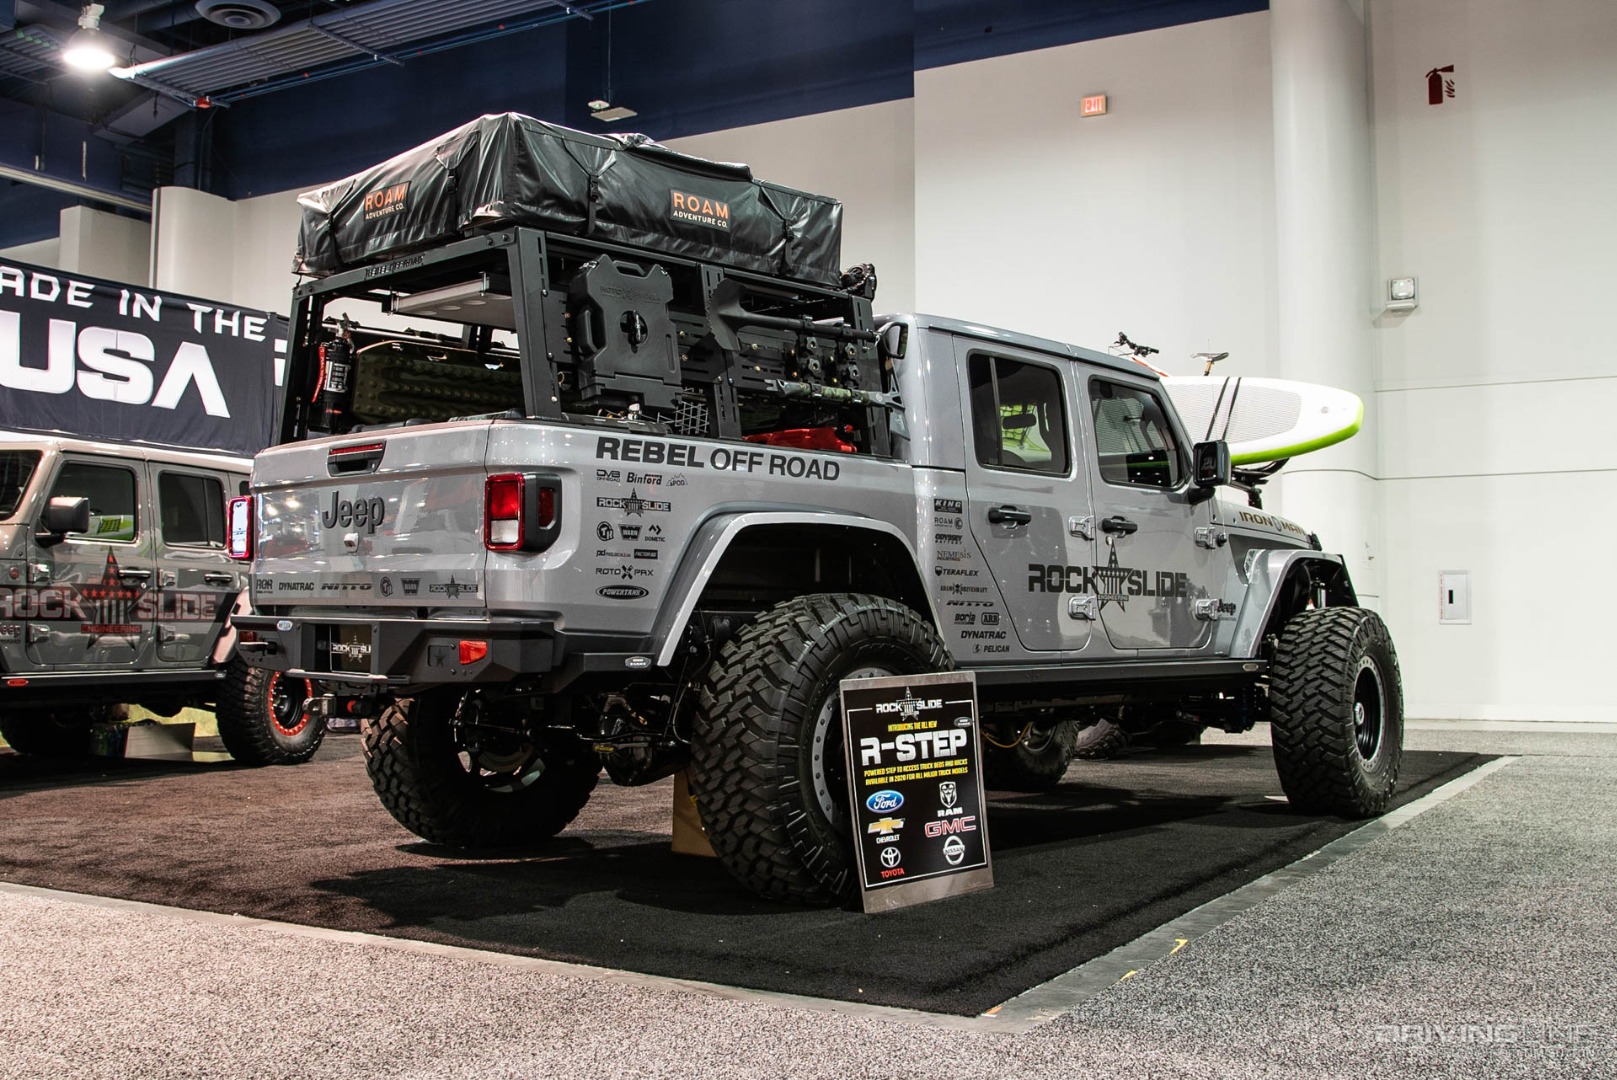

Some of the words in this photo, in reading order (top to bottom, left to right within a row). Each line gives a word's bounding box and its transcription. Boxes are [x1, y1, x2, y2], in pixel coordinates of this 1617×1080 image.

[1084, 96, 1104, 112] EXIT
[365, 183, 407, 211] ROAM
[365, 205, 395, 220] ADVENTURE
[673, 192, 729, 219] ROAM
[673, 210, 716, 225] ADVENTURE
[119, 289, 162, 322] IN
[187, 302, 267, 342] THE
[0, 309, 230, 418] USA
[596, 436, 705, 468] REBEL
[710, 448, 764, 473] OFF
[769, 454, 840, 481] ROAD
[627, 472, 662, 485] Binford
[598, 498, 627, 508] ROCK
[641, 500, 669, 511] SLIDE
[322, 490, 385, 534] Jeep
[1239, 512, 1273, 526] IRON
[935, 533, 963, 541] ODYSSEY
[595, 567, 621, 575] ROTO
[279, 582, 314, 591] DYNATRAC
[1028, 564, 1099, 594] ROCK
[1127, 570, 1187, 597] SLIDE
[430, 584, 448, 592] ROCK
[458, 584, 477, 592] SLIDE
[137, 592, 216, 620] SLIDE
[984, 614, 998, 623] ARB
[0, 624, 20, 639] eep
[82, 624, 141, 633] ENGINEERING
[961, 631, 1007, 639] DYNATRAC
[332, 644, 350, 652] ROCK
[984, 645, 1010, 653] PELICAN
[876, 702, 903, 713] ROCK
[917, 699, 943, 710] SLIDE
[888, 722, 914, 732] INTRODUCING
[860, 729, 967, 766] R-STEP
[864, 768, 885, 777] POWERED
[886, 766, 896, 774] STEP
[897, 765, 902, 773] TO
[903, 764, 919, 772] ACCESS
[920, 762, 933, 770] TRUCK
[866, 776, 888, 786] AVAILABLE
[889, 775, 894, 783] IN
[894, 774, 906, 782] 2020
[923, 770, 937, 778] MAJOR
[938, 768, 951, 776] TRUCK
[952, 766, 968, 774] MODELS
[873, 793, 897, 809] Ford
[937, 807, 963, 817] RAM
[925, 815, 976, 838] GMC
[876, 834, 900, 844] CHEVROLET
[944, 845, 964, 855] NISSAN
[881, 868, 905, 878] TOYOTA
